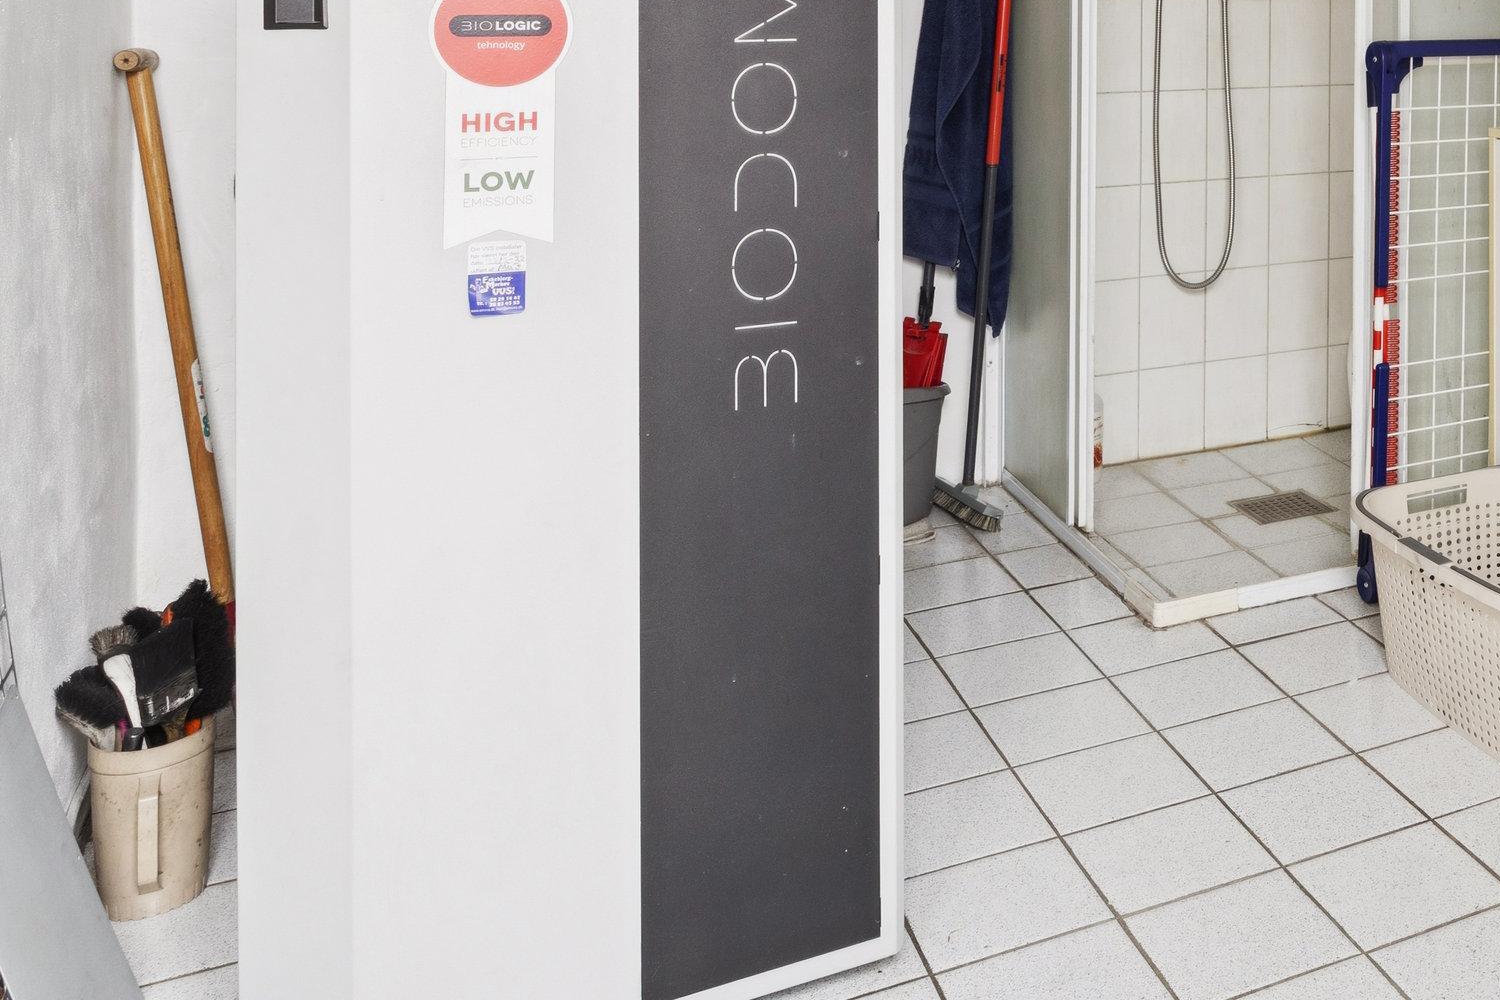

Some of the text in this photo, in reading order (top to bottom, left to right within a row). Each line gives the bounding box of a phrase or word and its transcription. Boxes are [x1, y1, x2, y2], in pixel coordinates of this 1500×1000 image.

[477, 40, 526, 51] tehnology
[461, 111, 539, 134] HIGH
[460, 136, 538, 149] EFFICIENCY
[463, 170, 536, 193] LOW
[463, 194, 534, 209] EMISSIONS
